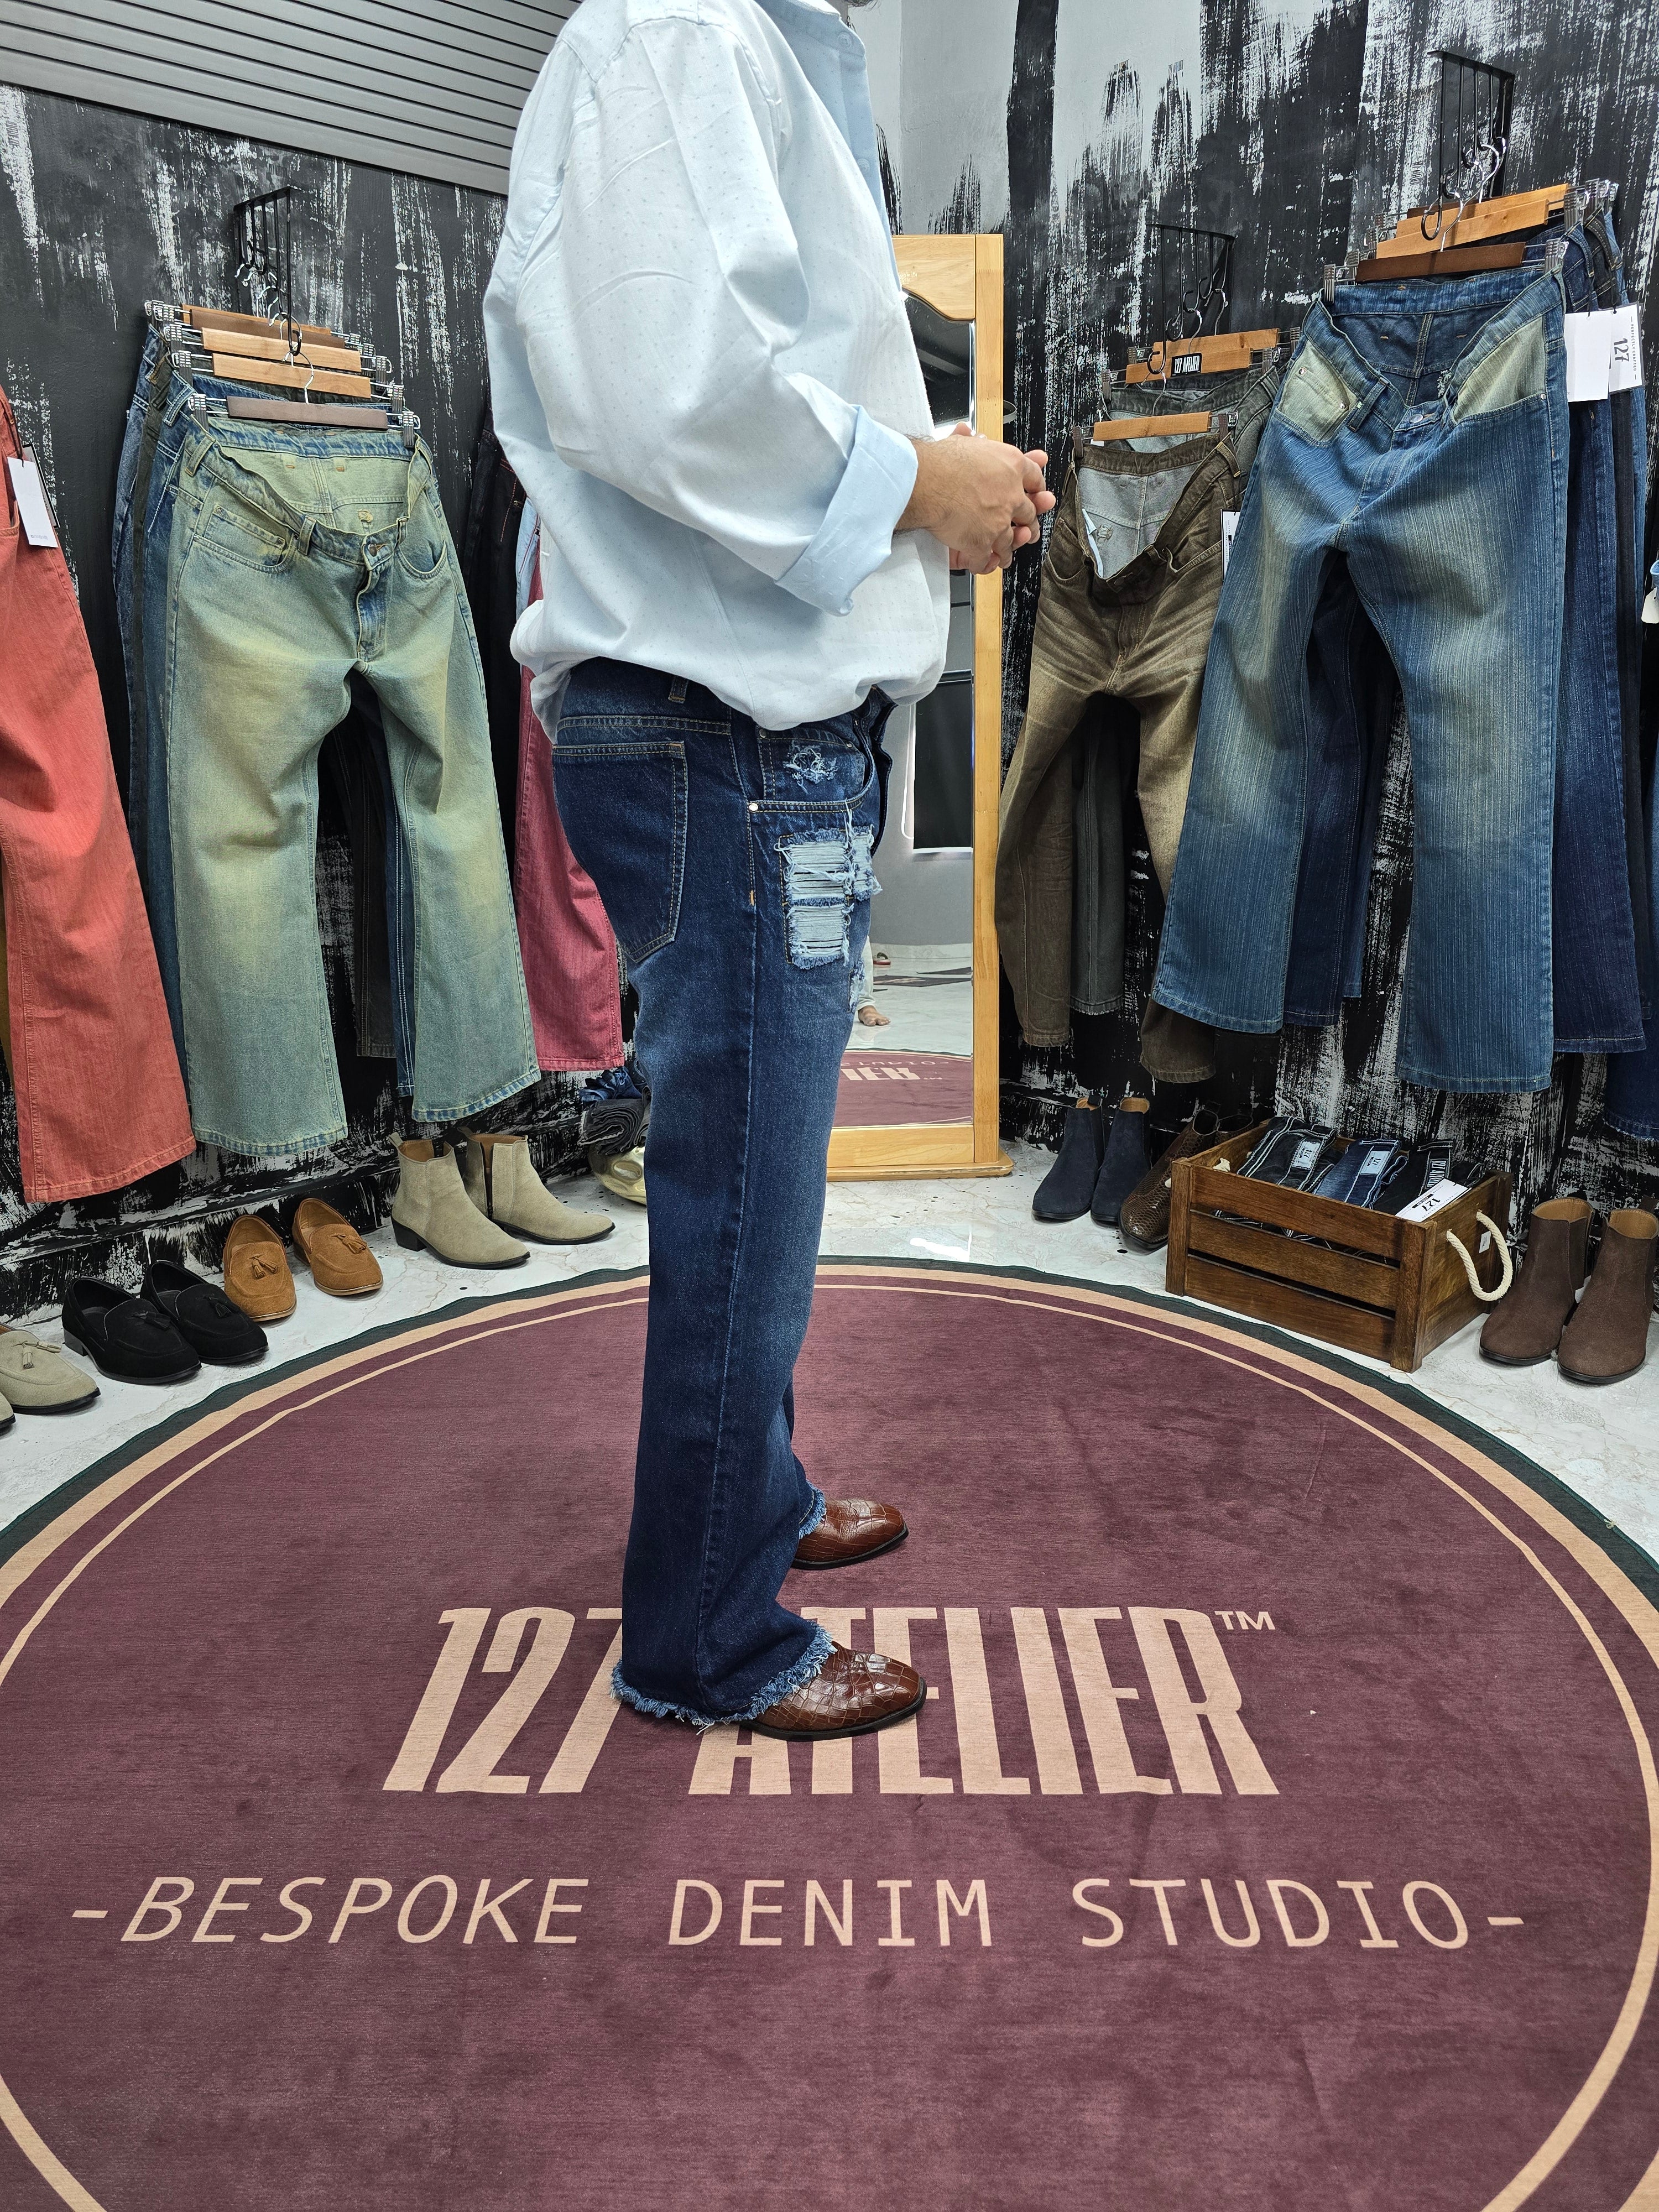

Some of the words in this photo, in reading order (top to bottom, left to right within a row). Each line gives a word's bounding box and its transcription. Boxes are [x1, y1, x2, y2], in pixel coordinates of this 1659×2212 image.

[1613, 338, 1630, 362] 127
[1174, 357, 1183, 374] 127
[1182, 355, 1200, 373] ATELIER
[1422, 1198, 1441, 1212] 127
[382, 1606, 623, 1794] 127
[668, 1879, 992, 1947] DENIM
